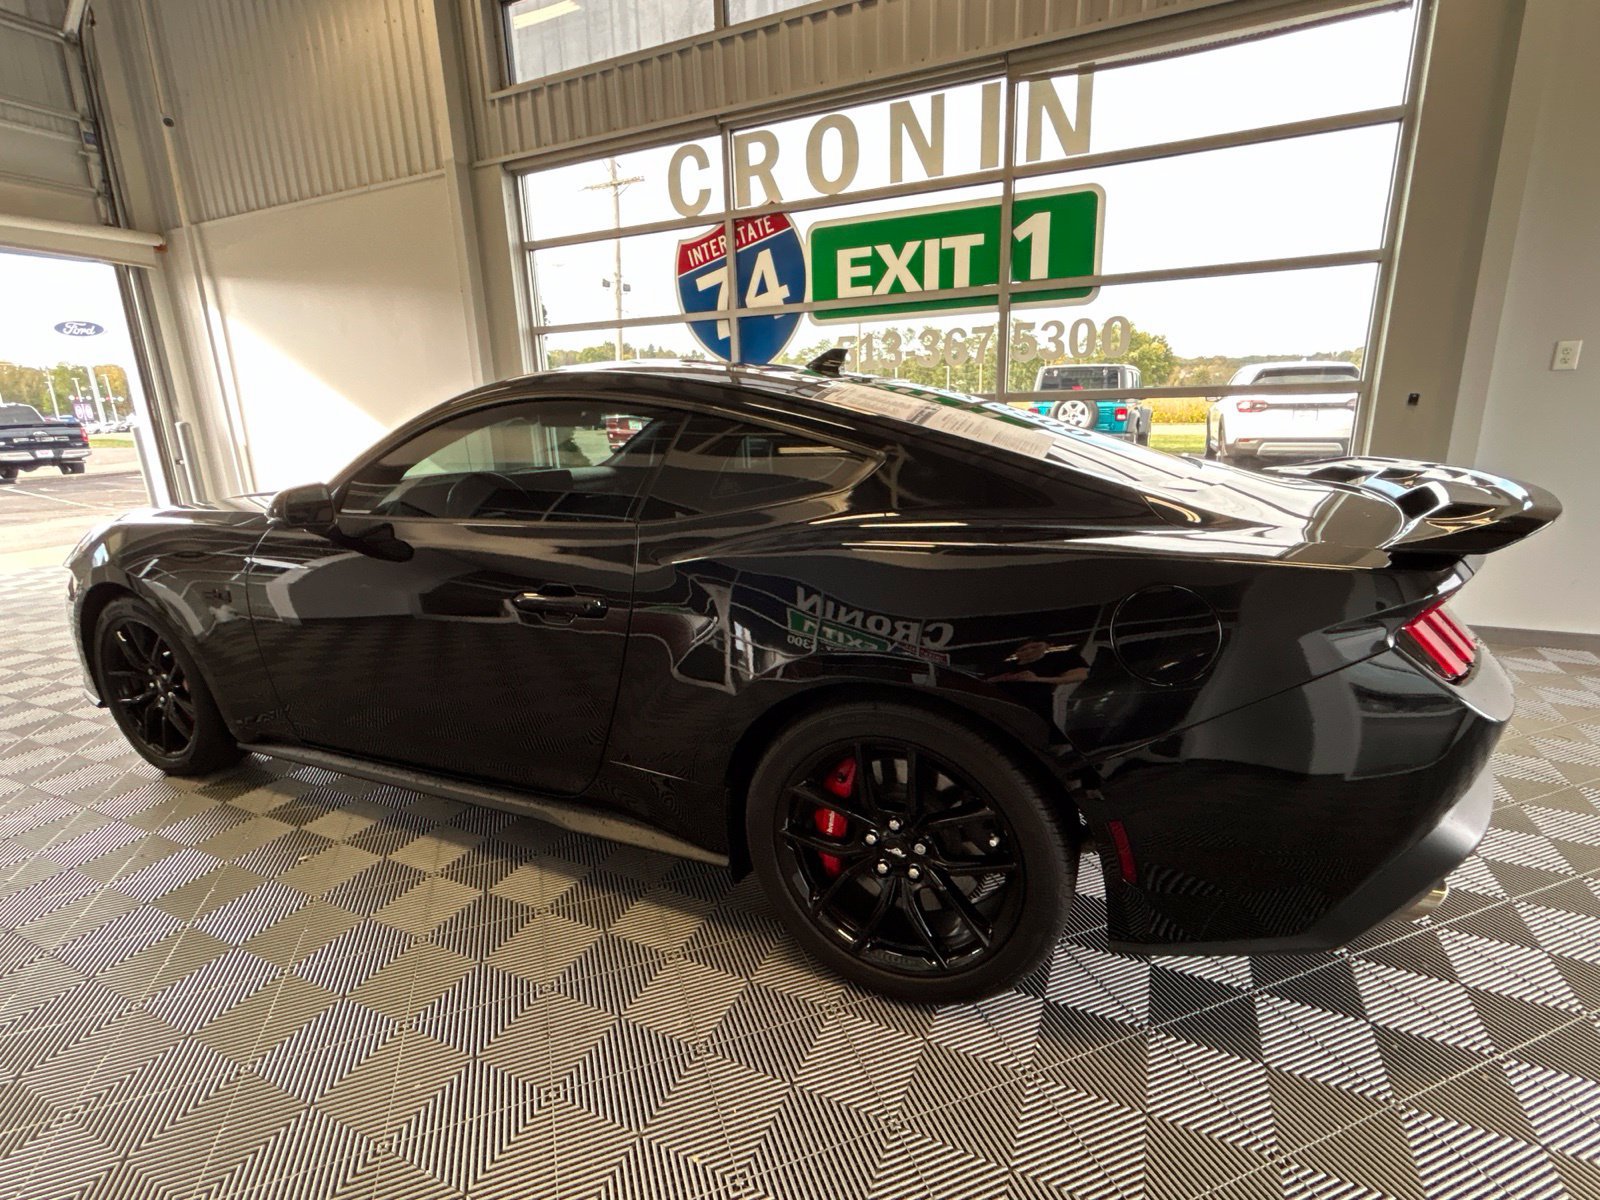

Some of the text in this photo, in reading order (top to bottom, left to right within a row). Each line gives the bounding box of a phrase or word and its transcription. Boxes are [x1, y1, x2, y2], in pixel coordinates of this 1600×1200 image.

[668, 63, 1095, 217] CRONIN
[688, 216, 775, 267] INTERTATE
[837, 211, 1051, 299] EXIT 1
[63, 322, 96, 335] Ford
[696, 248, 791, 340] 74
[836, 315, 1132, 371] 513-3675300
